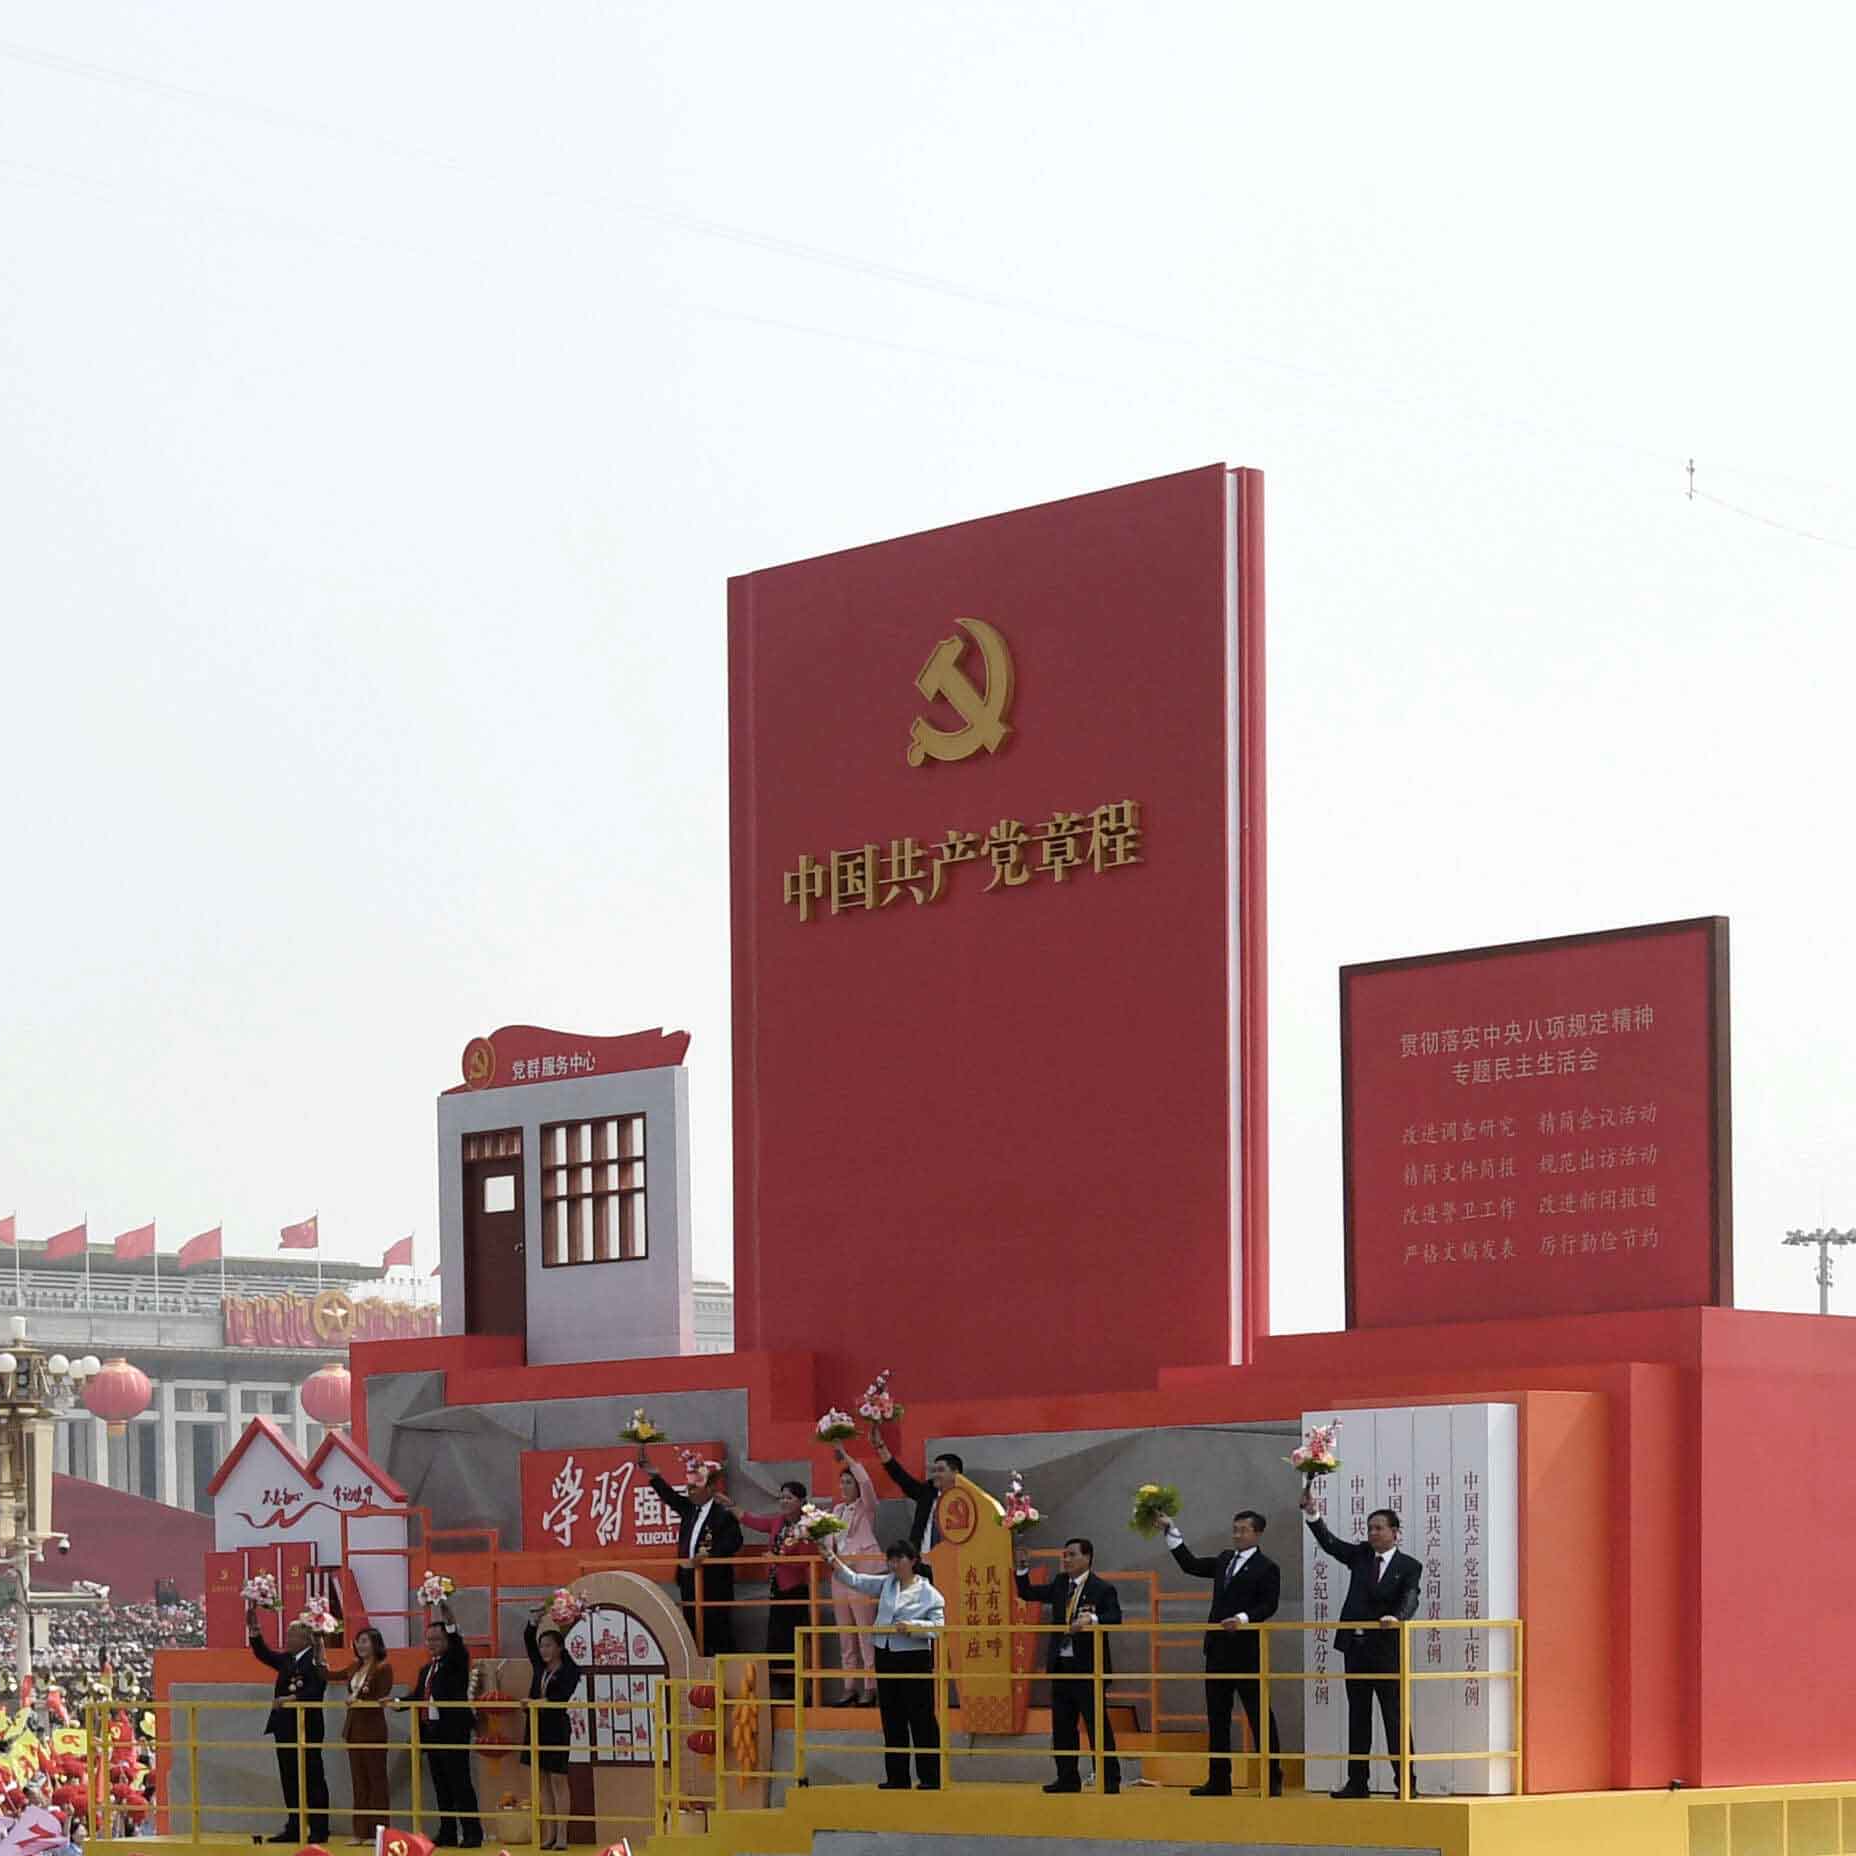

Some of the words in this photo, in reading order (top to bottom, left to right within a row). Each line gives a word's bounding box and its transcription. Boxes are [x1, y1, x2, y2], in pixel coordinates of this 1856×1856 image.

[783, 800, 1143, 922] 中国共产党章程
[1399, 1004, 1655, 1058] 贯彻落实中央八项规定精神
[511, 1051, 596, 1081] 党群服务中心
[1453, 1047, 1600, 1086] 专题民主生活会
[635, 1527, 680, 1545] xuexi.
